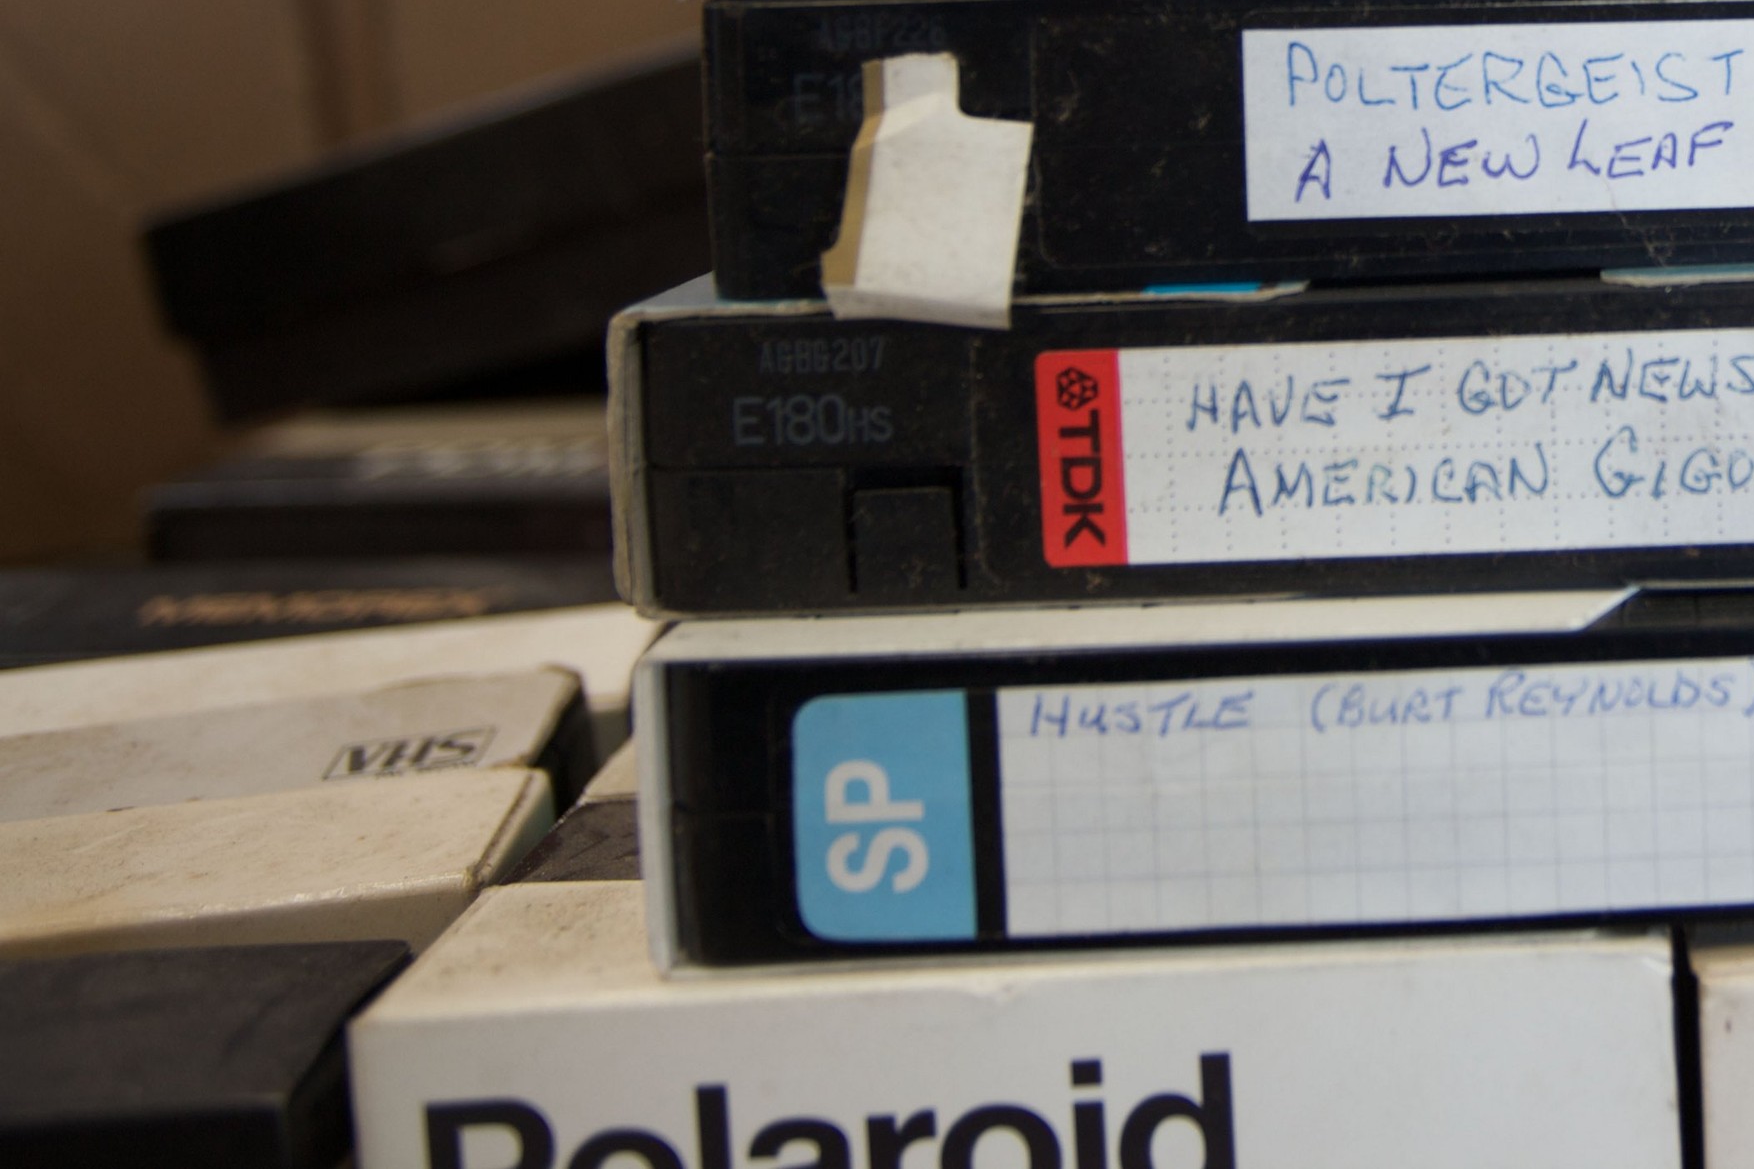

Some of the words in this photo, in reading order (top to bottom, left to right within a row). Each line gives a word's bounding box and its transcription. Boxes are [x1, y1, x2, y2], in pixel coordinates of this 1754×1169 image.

[1287, 42, 1745, 108] POLTERGEIST
[1295, 140, 1332, 202] A
[1383, 127, 1542, 189] NEW
[1567, 119, 1735, 181] LEAF
[1187, 374, 1353, 433] HAVE
[1375, 364, 1432, 423] I
[1059, 410, 1107, 550] TDK
[1217, 441, 1550, 518] AMERICAN
[1029, 689, 1255, 740] HUSTLE
[1311, 681, 1464, 733] (BURT
[347, 731, 480, 775] VHS
[822, 759, 930, 894] SP
